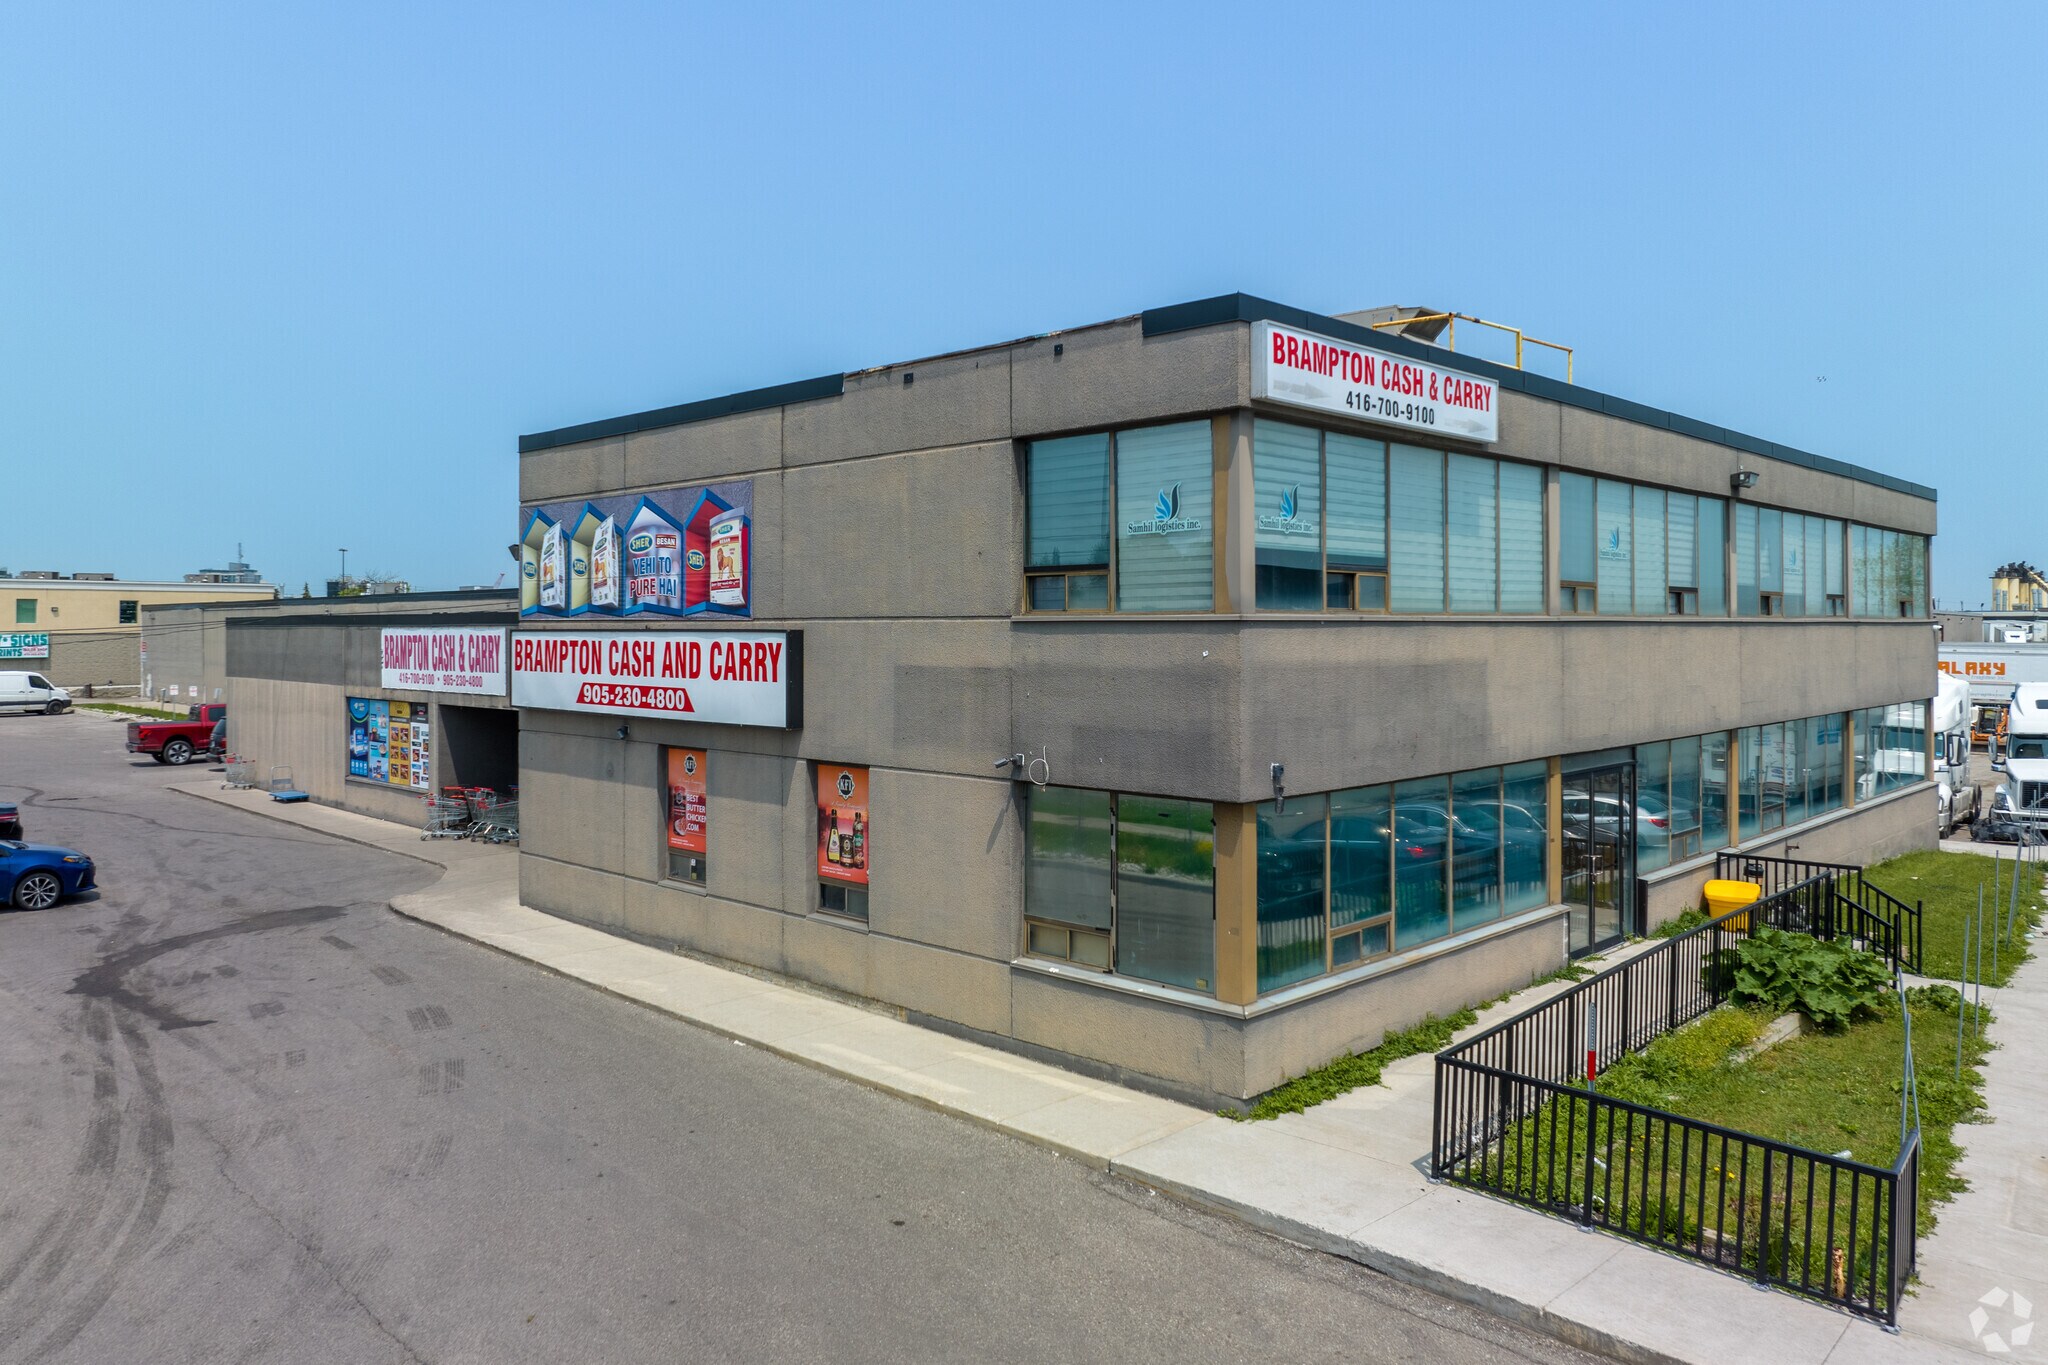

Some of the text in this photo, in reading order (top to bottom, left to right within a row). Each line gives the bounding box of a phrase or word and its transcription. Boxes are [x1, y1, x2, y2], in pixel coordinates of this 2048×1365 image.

[1272, 332, 1492, 412] BRAMPTON CASH & CARRY
[1346, 391, 1435, 425] 416-700-9100
[1128, 519, 1200, 533] Samhil logistics inc.
[631, 537, 676, 550] SHER BESAN
[633, 556, 672, 576] YEHI TO
[689, 552, 704, 566] SHER
[630, 578, 677, 598] PURE HAI
[11, 633, 47, 646] SIGNS
[384, 635, 501, 673] BRAMPTON CASH & CARRY
[514, 639, 783, 682] BRAMPTON CASH AND CARRY
[399, 673, 483, 688] 416-700-9100 905-230-4800
[583, 684, 686, 710] 905-230-4800
[686, 794, 699, 802] BEST
[686, 804, 706, 813] BUTTER
